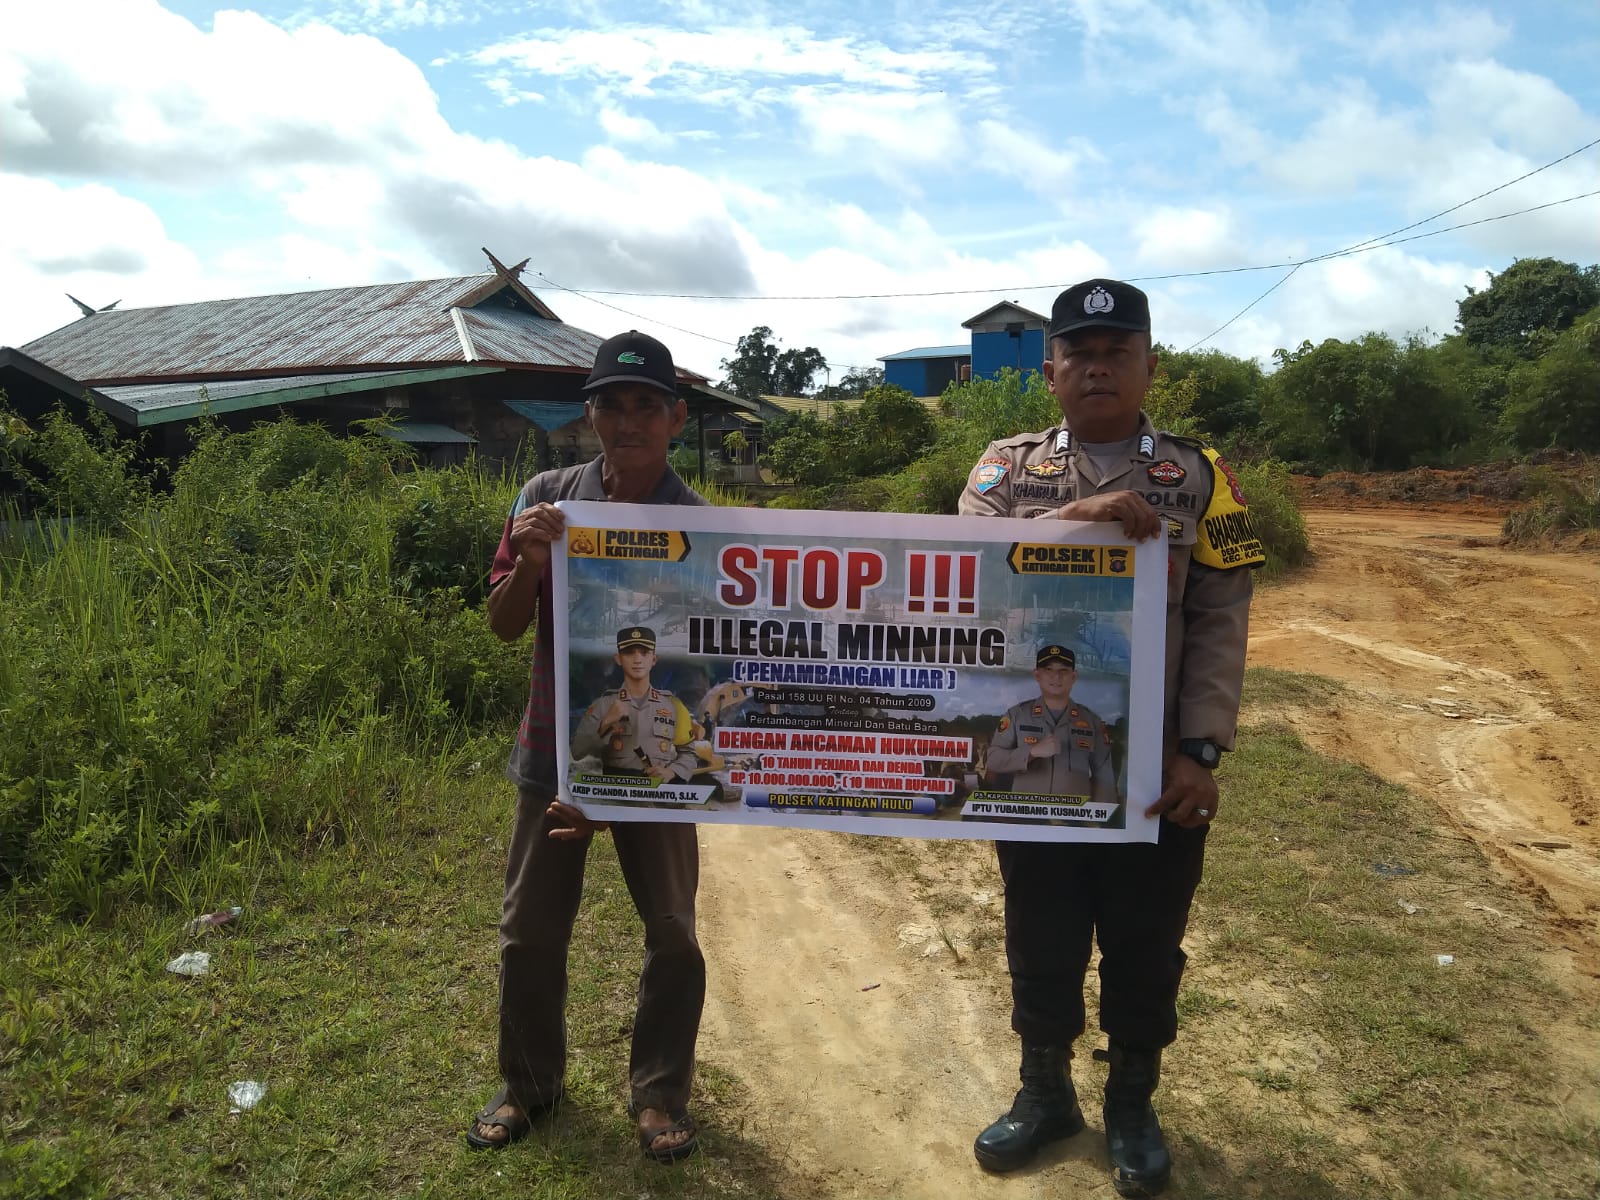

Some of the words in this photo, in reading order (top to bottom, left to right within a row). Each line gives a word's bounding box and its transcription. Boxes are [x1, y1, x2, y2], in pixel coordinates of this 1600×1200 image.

[1140, 490, 1197, 509] OLRI
[605, 530, 669, 547] POLRES
[605, 546, 669, 559] KATINGAN
[1022, 547, 1096, 562] POLSEK
[1222, 554, 1242, 564] KEC.
[1022, 562, 1069, 573] KATINGAN
[1070, 564, 1096, 574] HULU
[719, 546, 884, 610] STOP
[907, 553, 977, 614] !!!
[689, 617, 828, 660] ILLEGAL
[837, 623, 1005, 667] MINNING
[746, 662, 896, 689] PENAMBANGAN
[900, 668, 943, 690] LIAR
[758, 691, 785, 701] Pasal
[788, 692, 804, 702] 158
[808, 694, 823, 702] UU
[826, 694, 838, 703] RI
[859, 696, 871, 705] 04
[874, 696, 905, 707] Tahun
[908, 698, 932, 708] 2009
[750, 716, 822, 728] Pertambangan
[825, 718, 862, 729] Mineral
[865, 721, 884, 730] Dan
[888, 722, 911, 731] Batu
[914, 723, 938, 732] Bara
[718, 731, 789, 750] DENGAN
[790, 734, 876, 754] ANCAMAN
[880, 737, 969, 758] HUKUMAN
[762, 756, 775, 769] 10
[777, 756, 812, 770] TAHUN
[814, 758, 860, 772] PENJARA
[863, 760, 885, 773] DAN
[887, 760, 922, 774] DENDA
[582, 775, 614, 784] KAPOLRES
[730, 772, 746, 785] RP.
[850, 777, 862, 789] 10
[864, 778, 902, 790] MILYAR
[904, 779, 946, 792] RUPIAH
[572, 784, 590, 795] AKBP
[592, 786, 628, 798] CHANDRA
[630, 788, 678, 801] ISMAWANTO,
[679, 790, 699, 800] S.I.K.
[768, 794, 815, 806] POLSEK
[818, 796, 877, 809] KATINGAN
[881, 798, 913, 811] HULU
[972, 804, 992, 812] IPTU
[994, 804, 1048, 816] YUBAMBANG
[1050, 808, 1093, 820] KUSNADY,
[1095, 810, 1107, 818] SH
